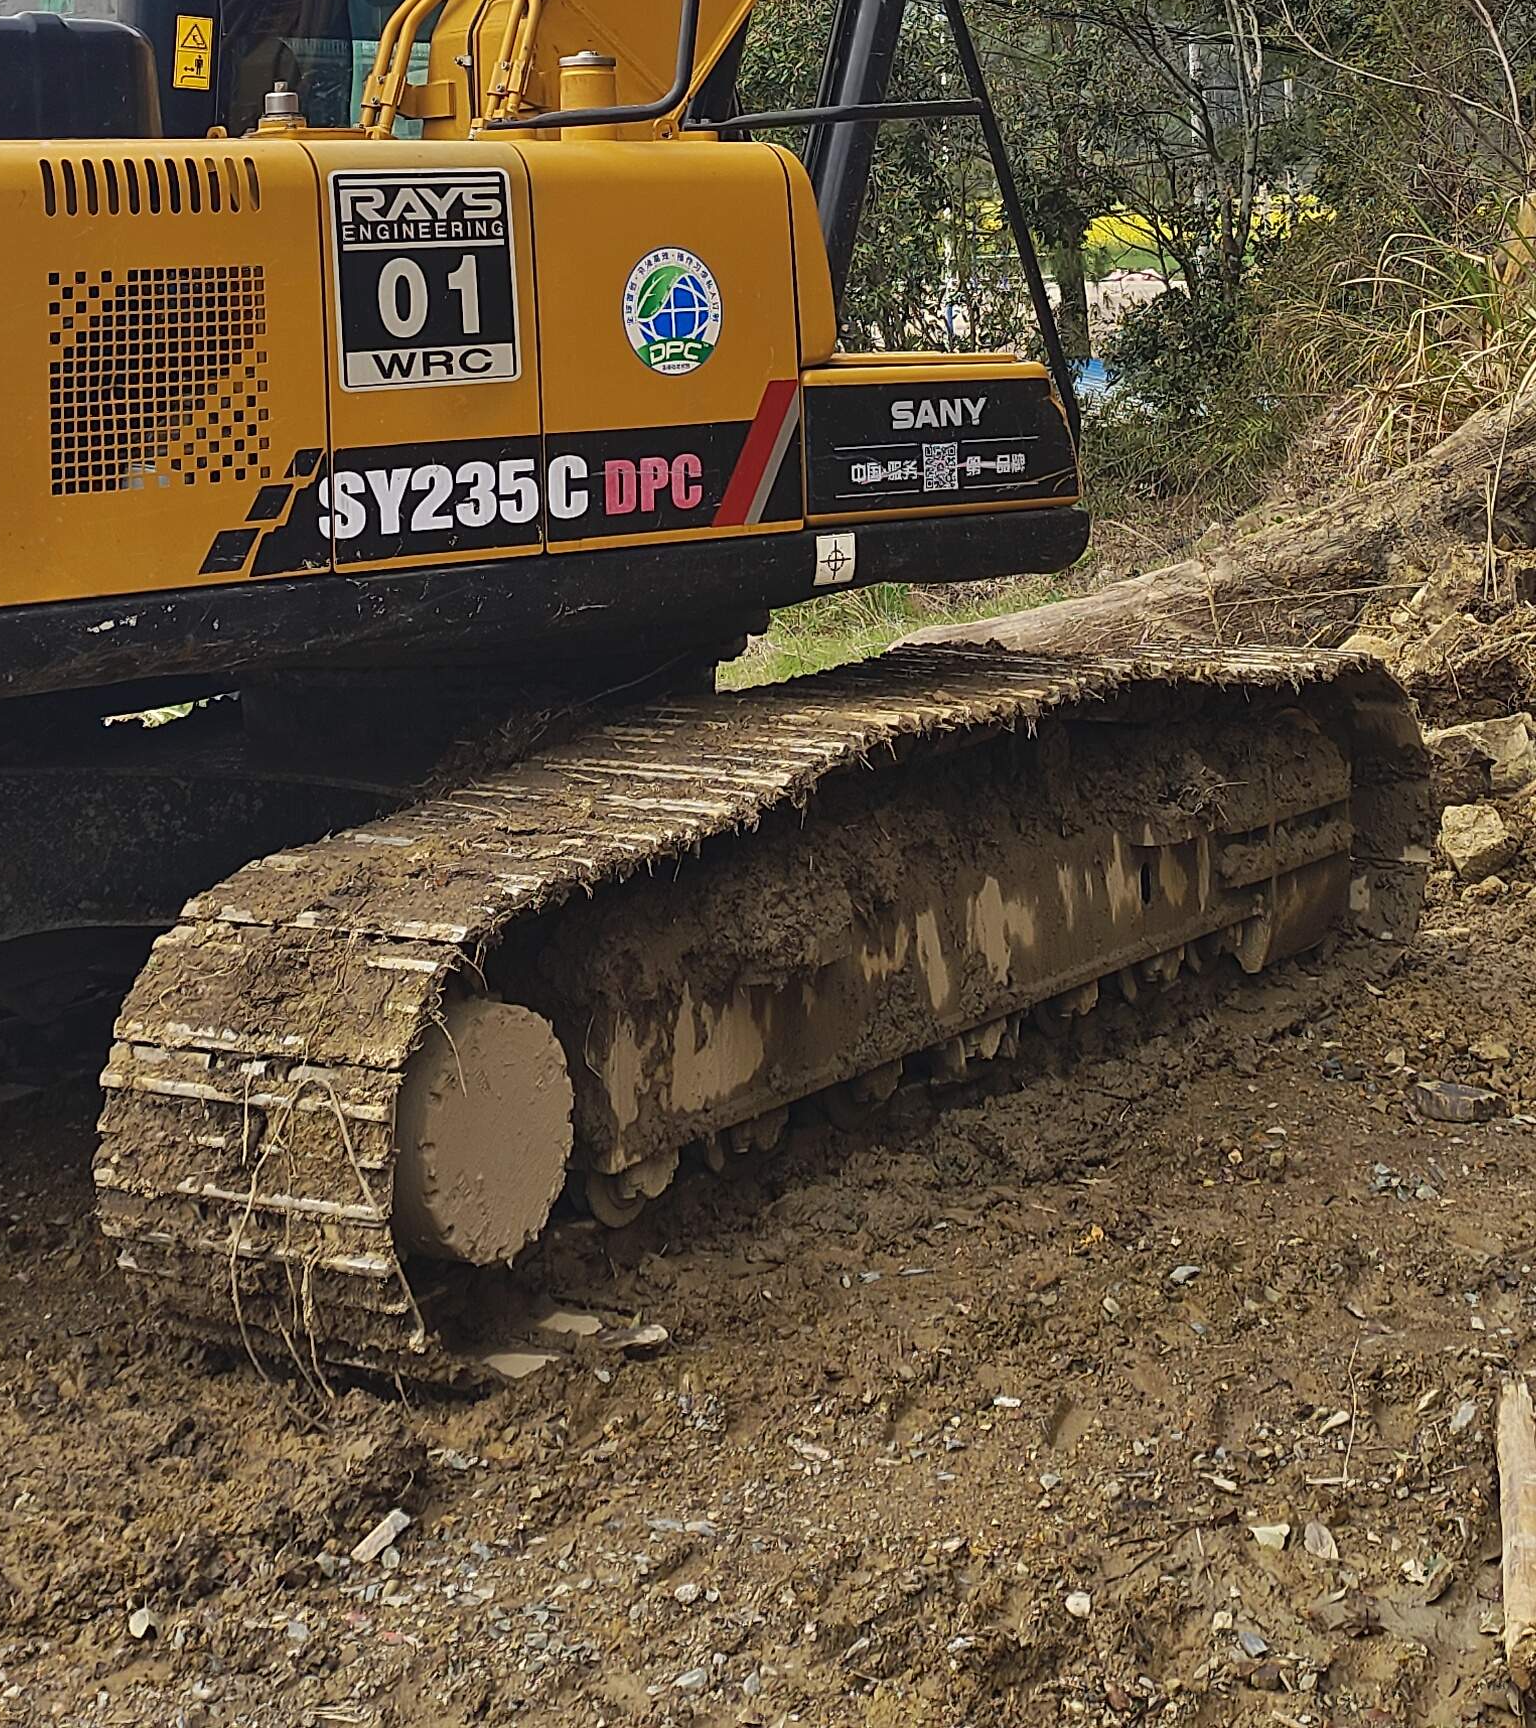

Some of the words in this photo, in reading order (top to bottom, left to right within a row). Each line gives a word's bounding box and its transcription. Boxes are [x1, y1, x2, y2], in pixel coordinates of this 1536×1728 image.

[339, 186, 502, 223] RAYS
[342, 220, 505, 242] ENGINEERING
[378, 254, 480, 339] 01
[371, 348, 493, 380] WRC
[649, 340, 702, 365] DPC
[891, 397, 987, 430] SANY
[318, 454, 588, 540] SY235C
[604, 453, 703, 516] DPC
